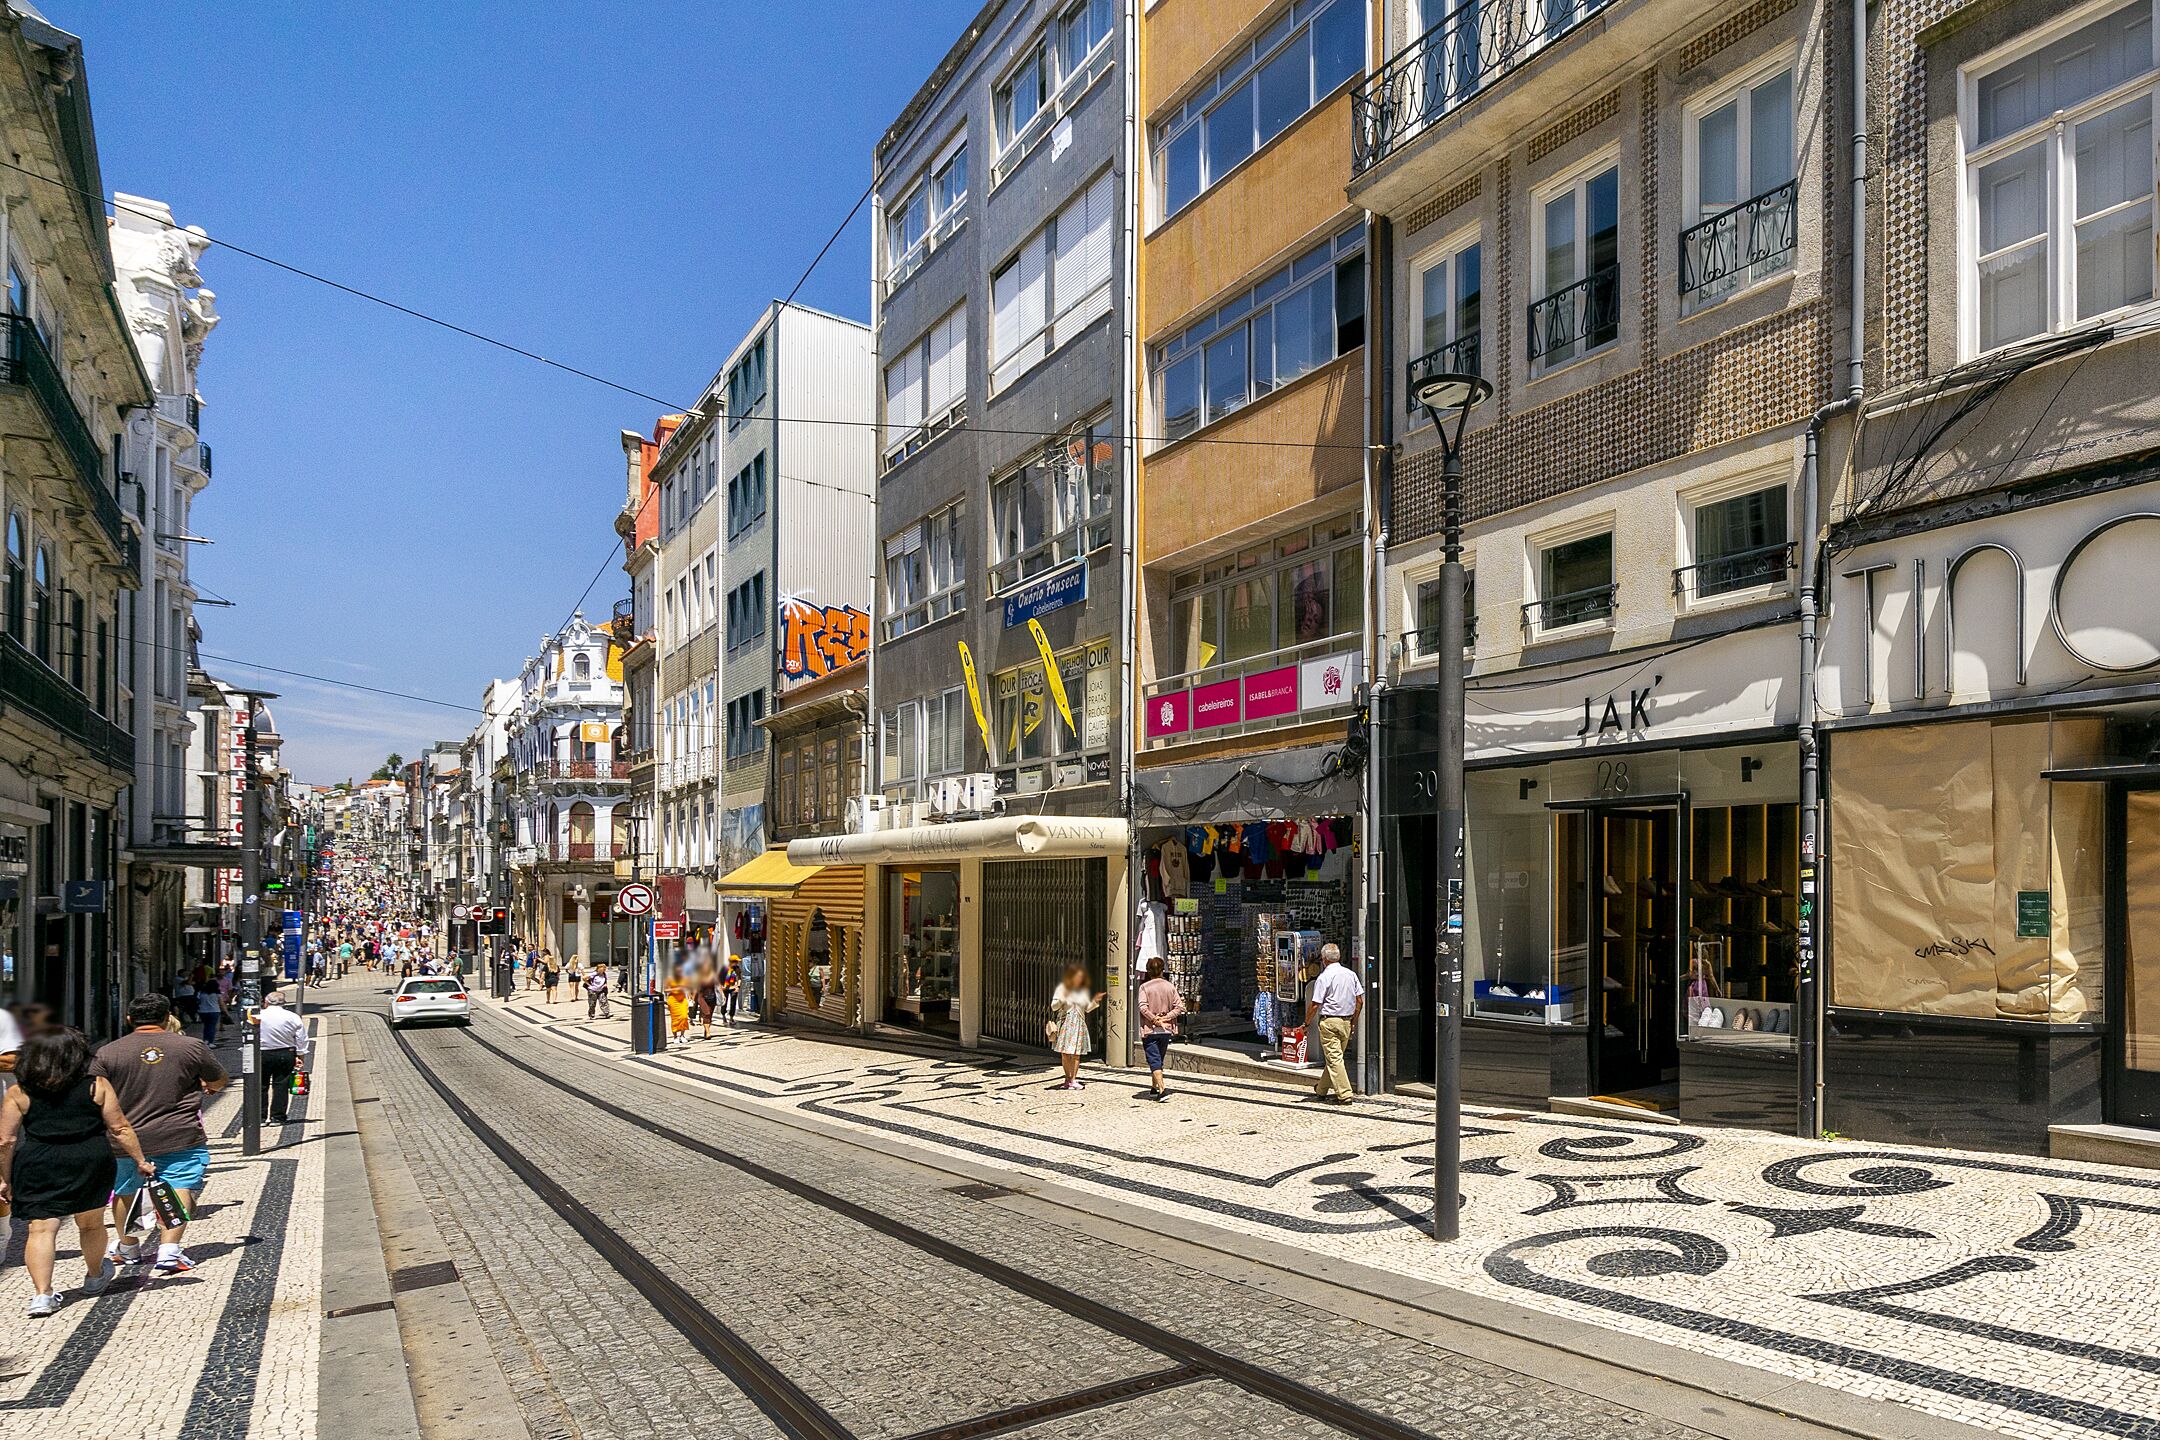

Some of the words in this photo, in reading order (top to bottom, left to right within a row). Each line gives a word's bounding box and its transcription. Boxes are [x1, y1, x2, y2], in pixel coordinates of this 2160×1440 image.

[1018, 586, 1044, 608] Onório
[1046, 573, 1081, 597] Fonseca
[1032, 597, 1064, 617] Cabeleireiros
[1198, 697, 1234, 713] cabeleireiros
[1412, 770, 1438, 799] 30
[1597, 760, 1630, 792] 28
[1046, 825, 1106, 840] VANNY
